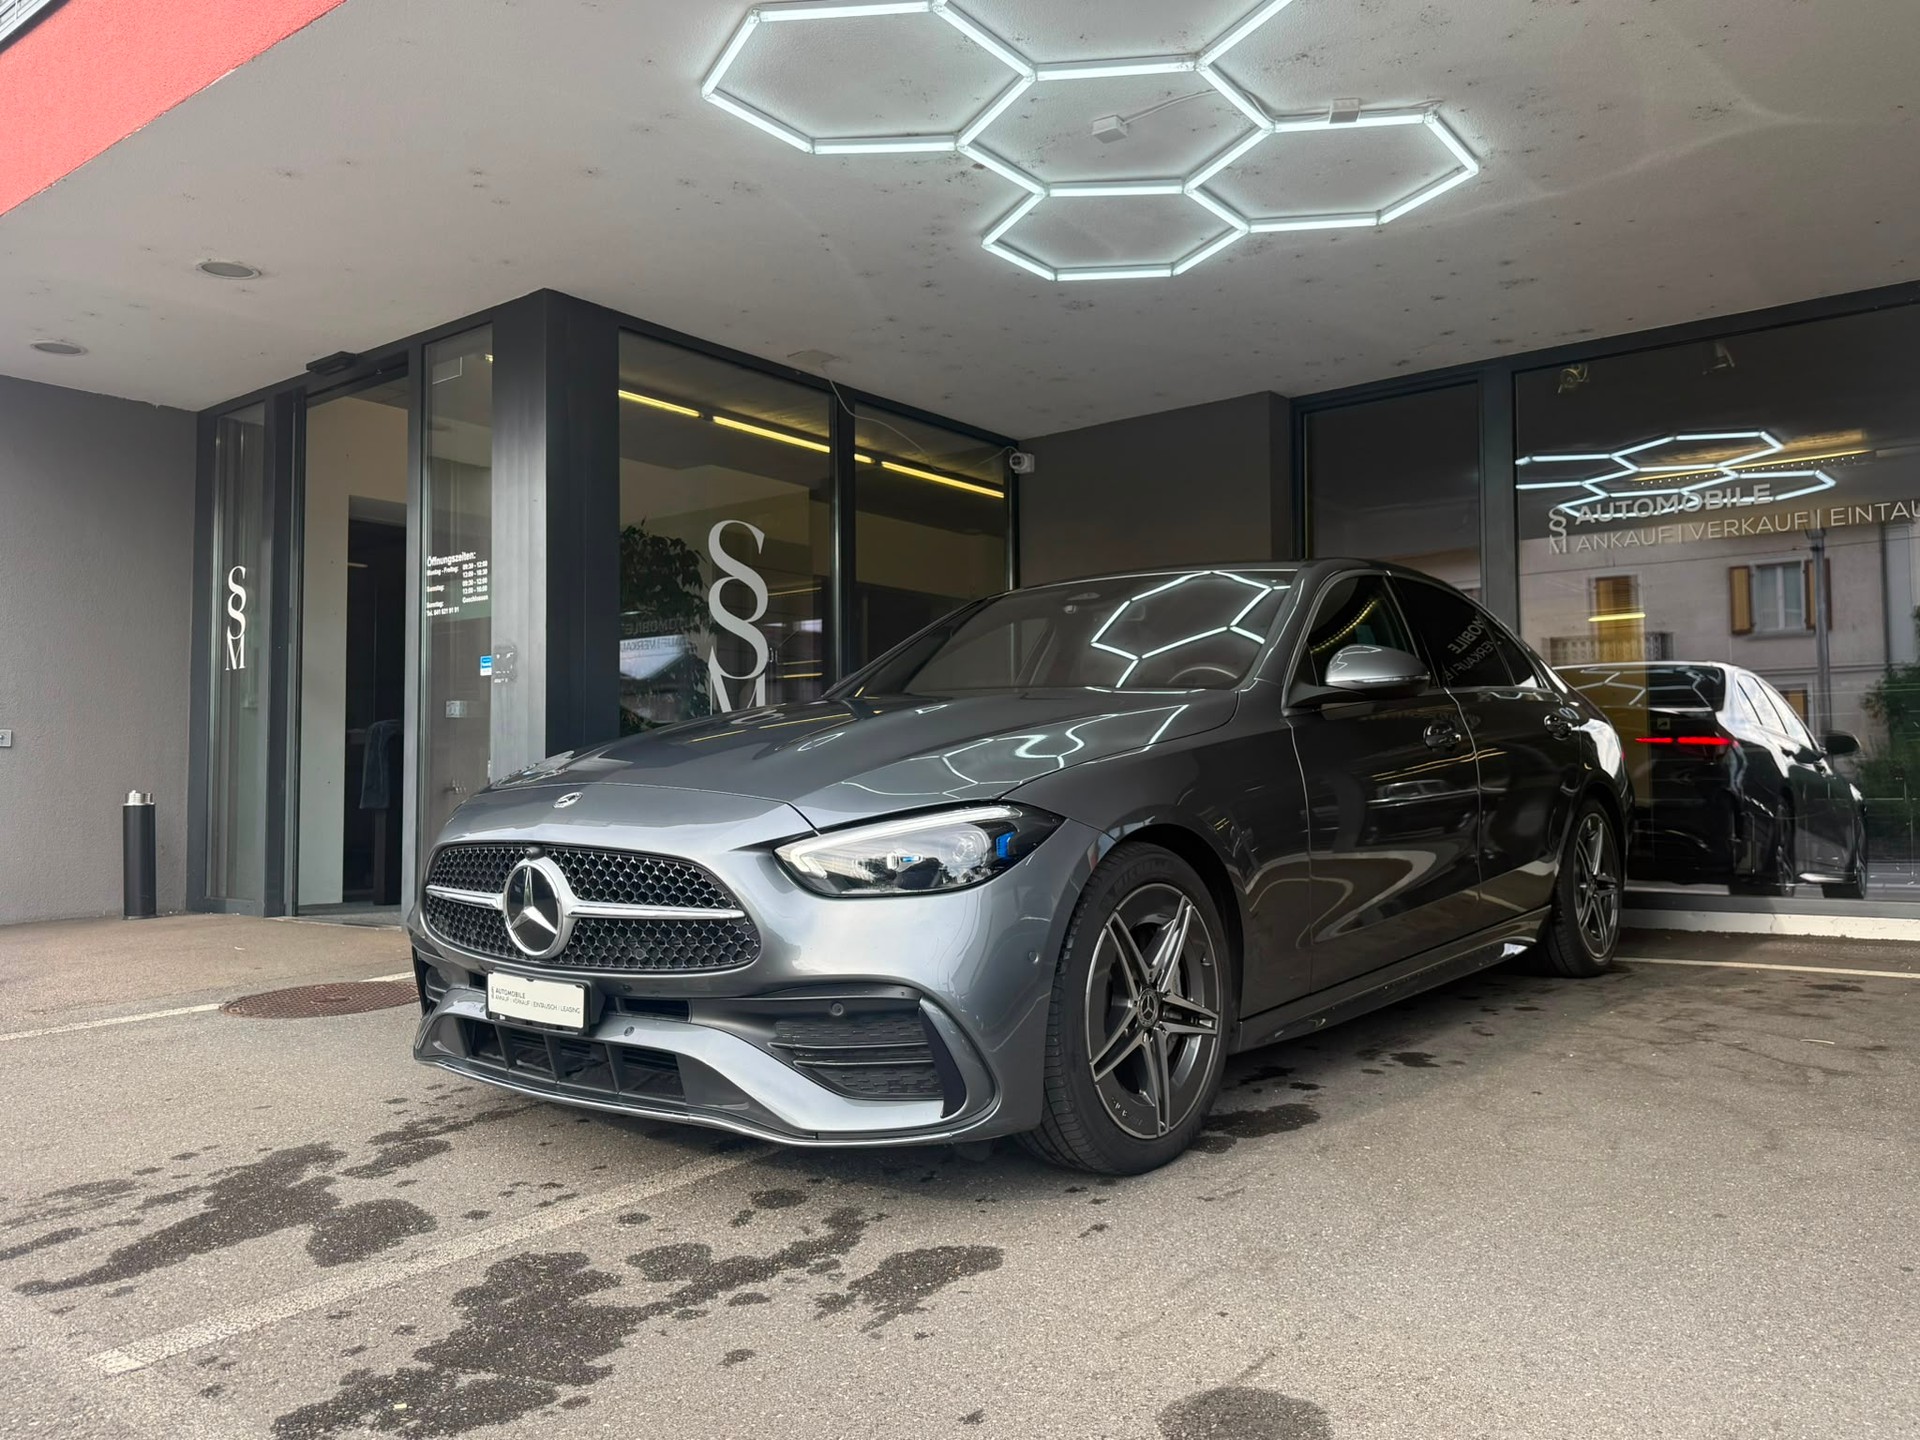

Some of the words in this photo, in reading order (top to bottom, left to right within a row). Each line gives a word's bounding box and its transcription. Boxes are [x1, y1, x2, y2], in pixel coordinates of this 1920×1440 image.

[1574, 484, 1772, 526] AUTOMOBILE
[1575, 525, 1674, 553] ANKAUF
[1689, 511, 1809, 541] VERKAUF
